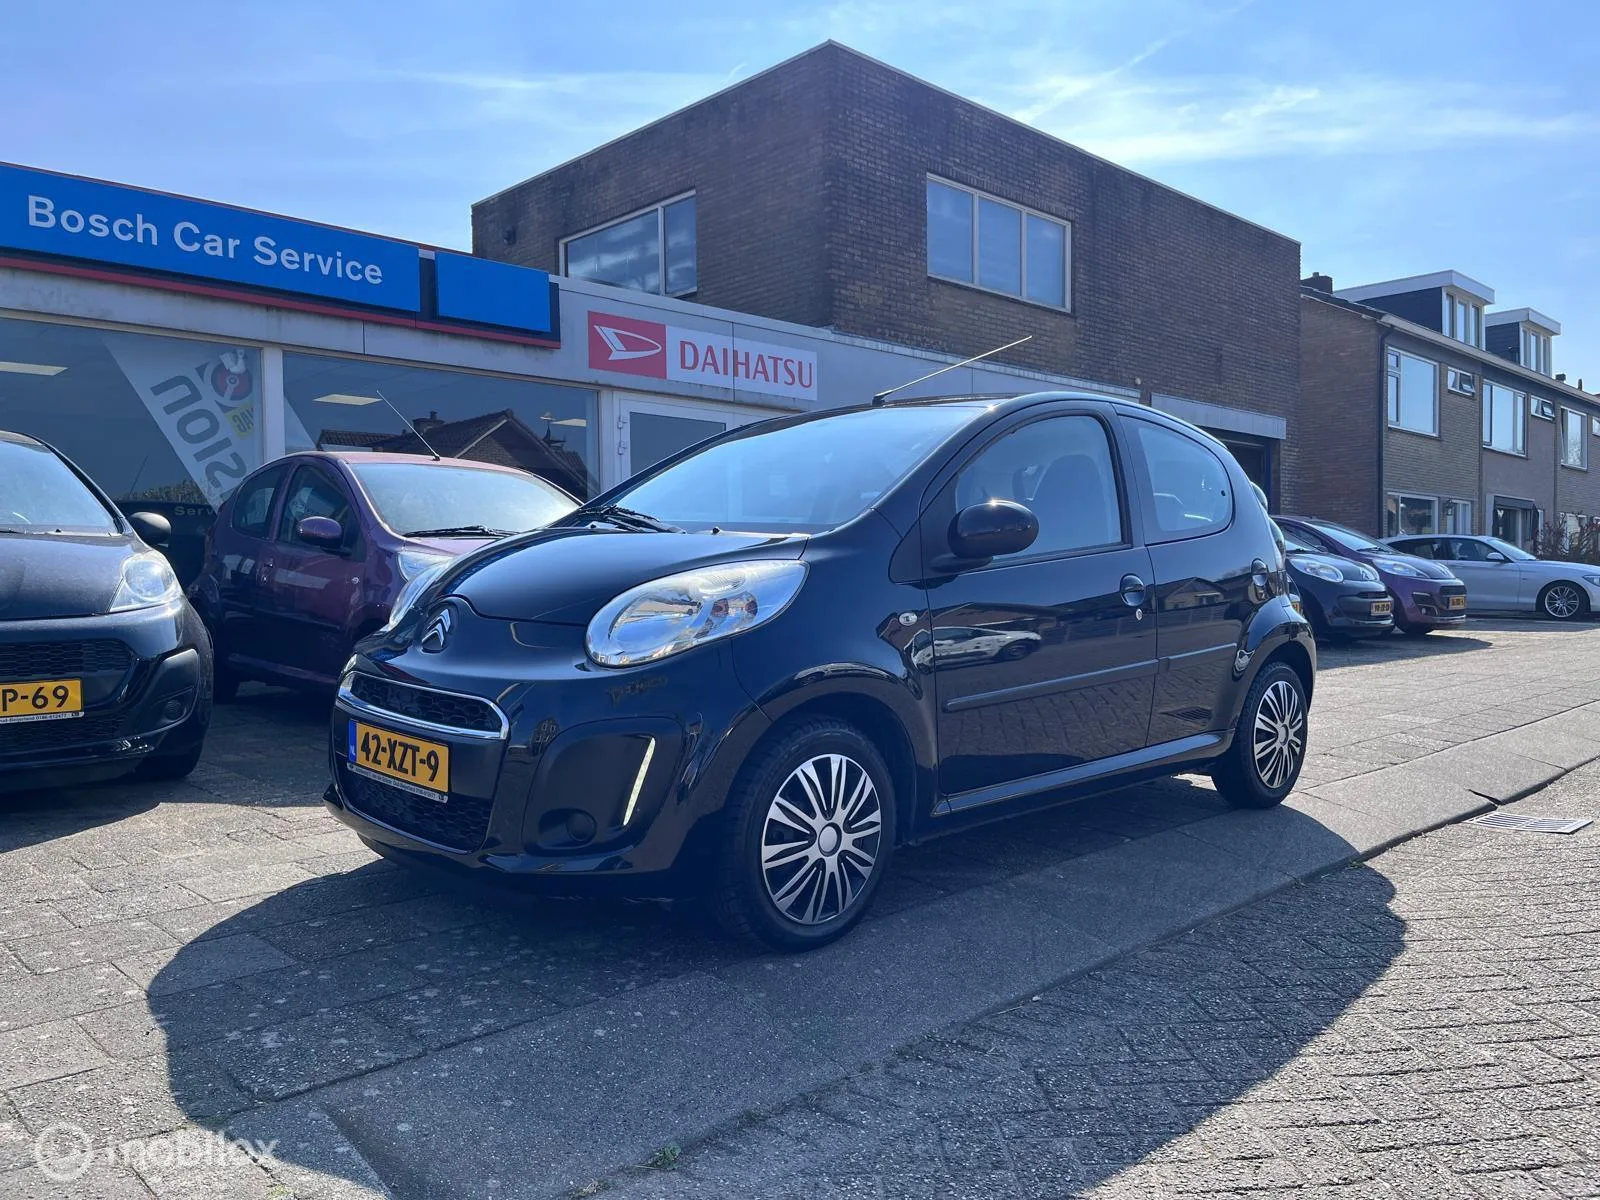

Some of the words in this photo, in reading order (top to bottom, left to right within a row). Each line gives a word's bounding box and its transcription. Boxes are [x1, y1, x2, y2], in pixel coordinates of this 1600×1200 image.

[28, 195, 158, 245] Bosch
[174, 221, 240, 259] Car
[253, 236, 383, 284] Service
[679, 340, 813, 388] DAIHATSU
[2, 685, 69, 712] P-69
[361, 731, 439, 782] 42-XZT-9
